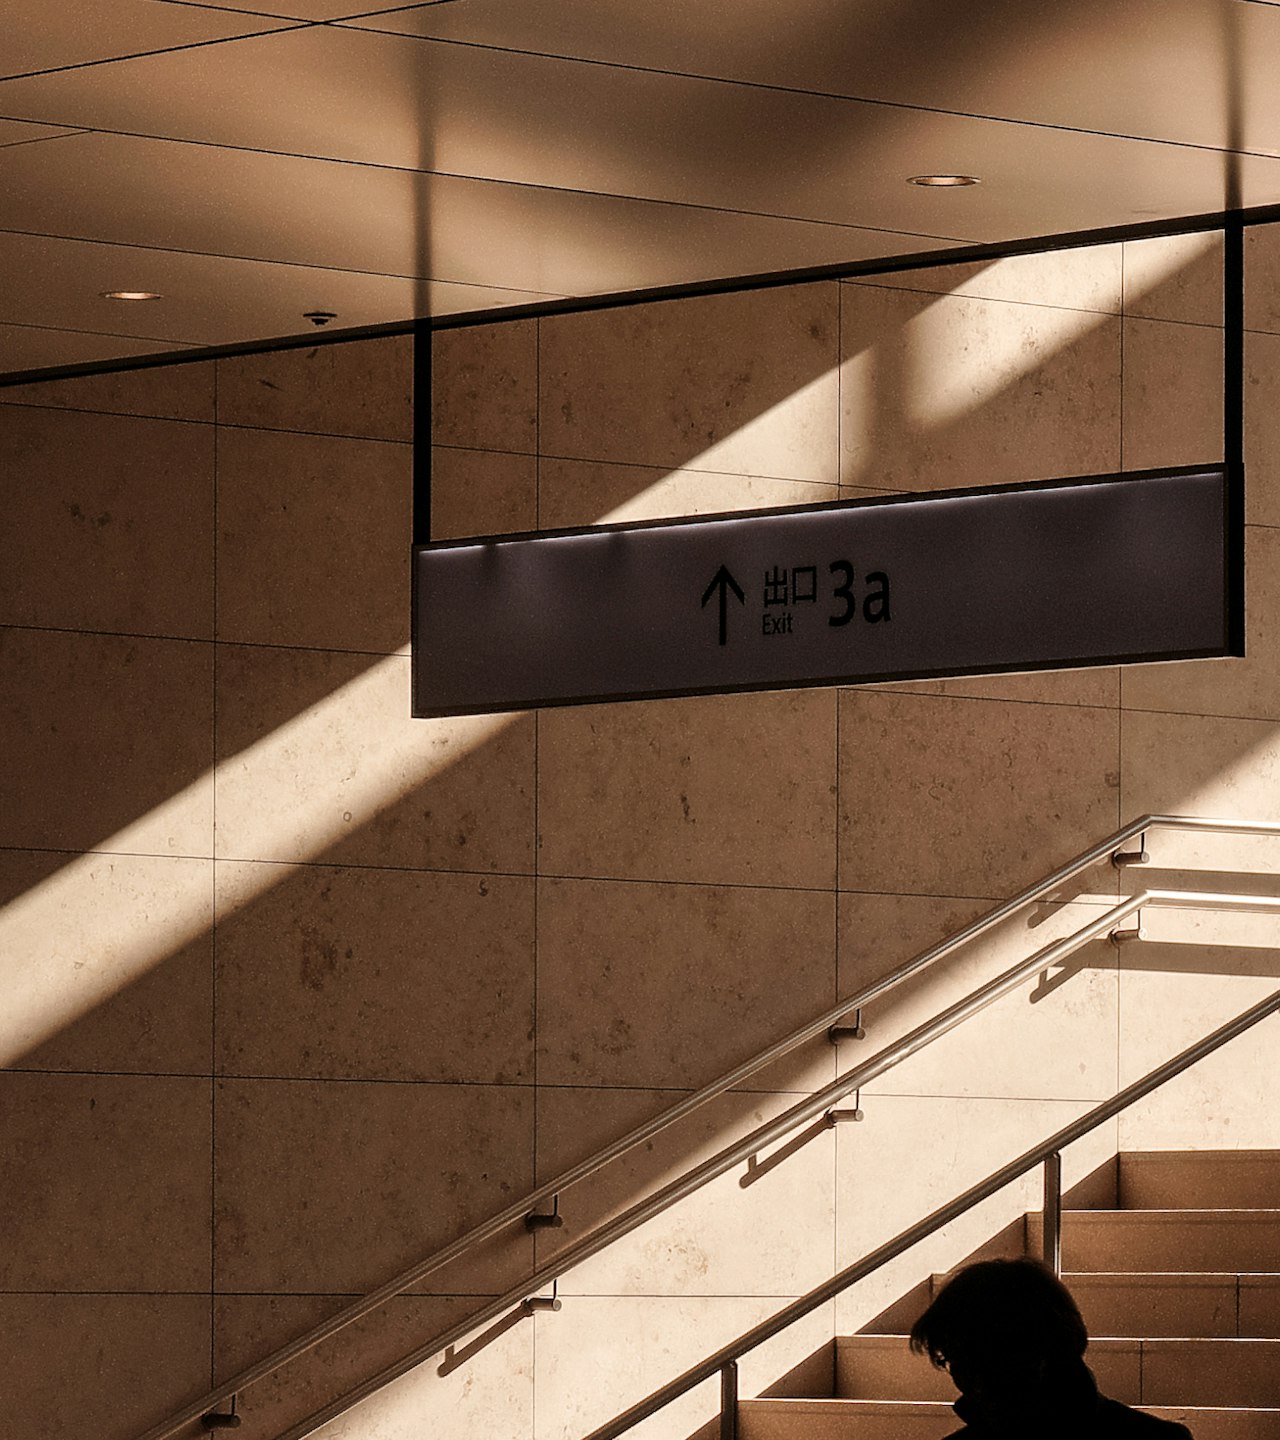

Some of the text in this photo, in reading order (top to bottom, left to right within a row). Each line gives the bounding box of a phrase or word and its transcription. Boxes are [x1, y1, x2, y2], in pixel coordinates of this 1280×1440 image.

[764, 560, 891, 627] 出口 3a
[762, 612, 794, 635] Exit
